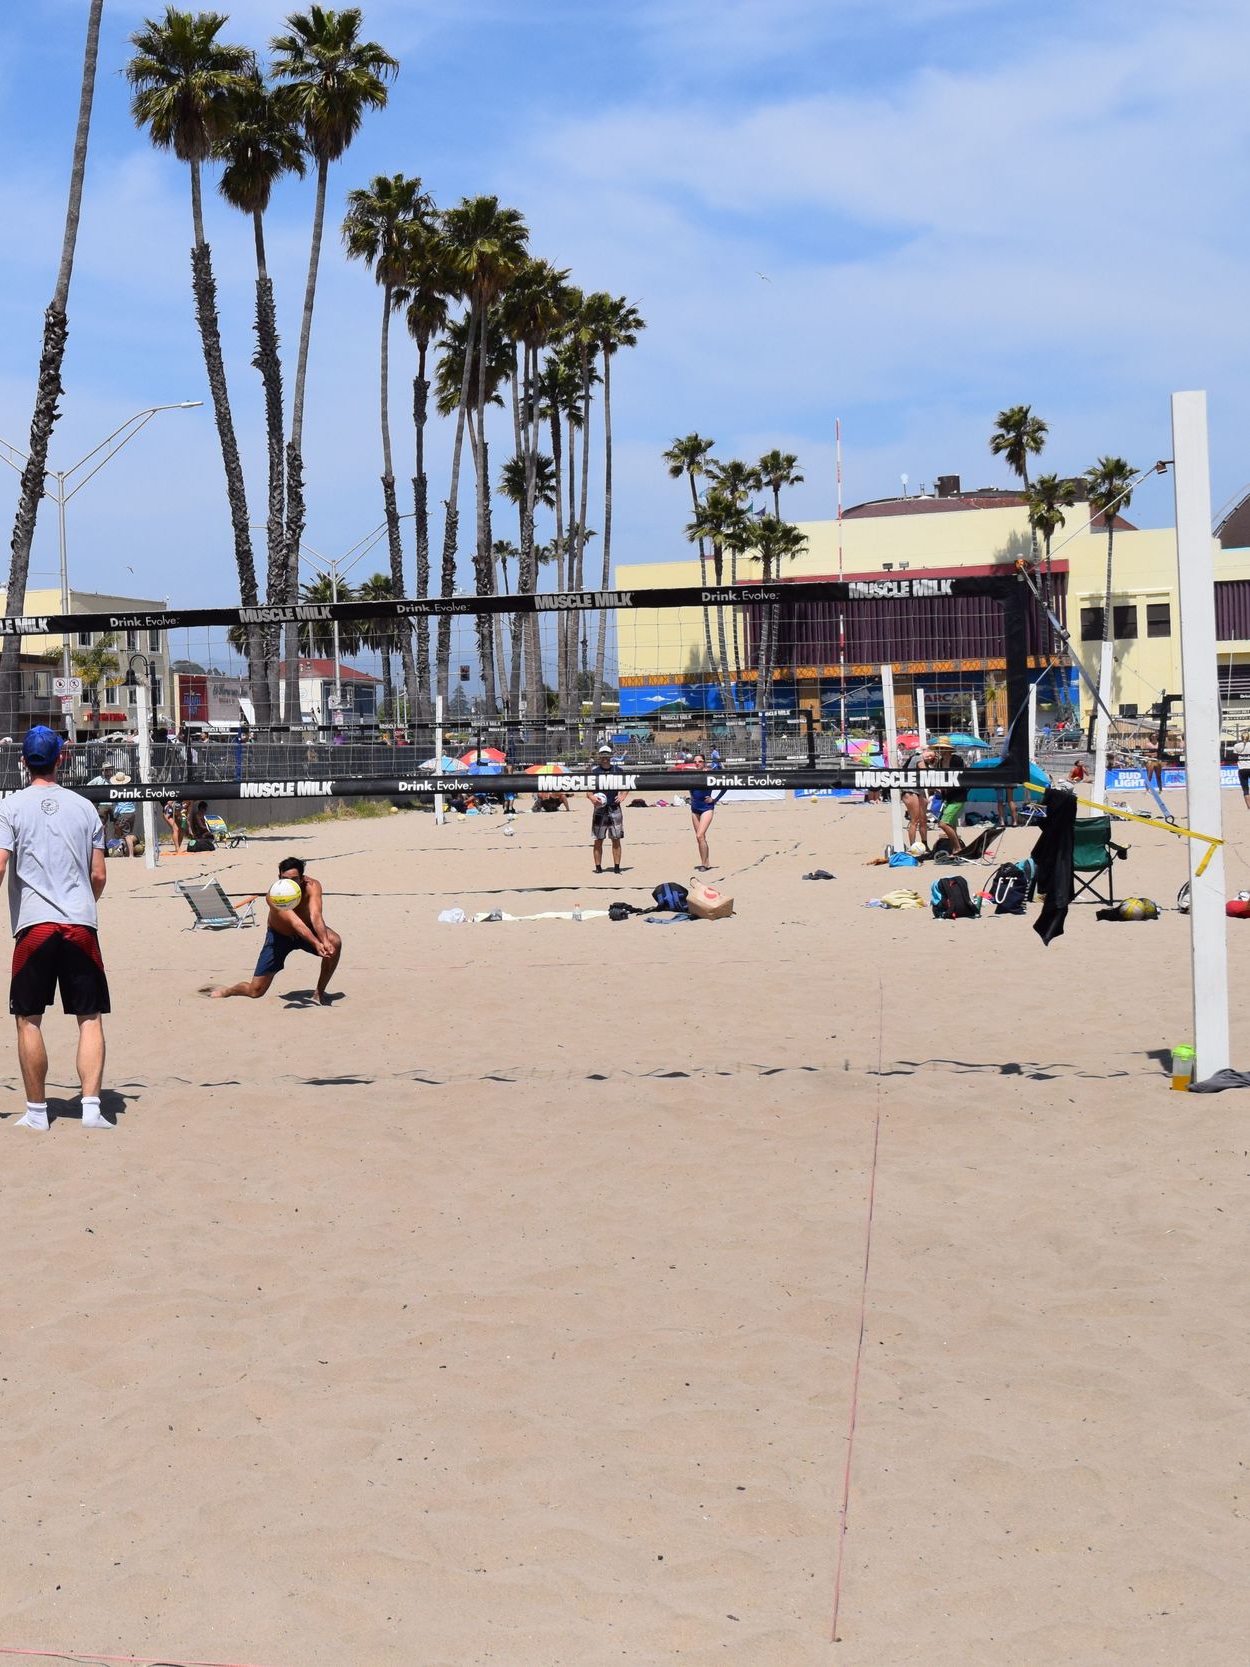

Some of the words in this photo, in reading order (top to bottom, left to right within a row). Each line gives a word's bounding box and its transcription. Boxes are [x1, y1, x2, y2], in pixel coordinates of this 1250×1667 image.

[848, 581, 910, 599] MUSCLE
[912, 579, 953, 596] MILK
[534, 594, 593, 610] MUSCLE
[594, 592, 633, 607] MILK
[239, 606, 295, 623] MUSCLE
[295, 605, 333, 620] MILK
[15, 617, 49, 633] MILK
[537, 774, 596, 791] MUSCLE
[598, 773, 637, 790] MILK
[854, 771, 917, 787] MUSCLE
[919, 770, 960, 787] MILK
[1114, 779, 1146, 787] LIGHT
[1118, 772, 1141, 780] BUD
[239, 782, 295, 798] MUSCLE
[297, 780, 333, 796] MILK
